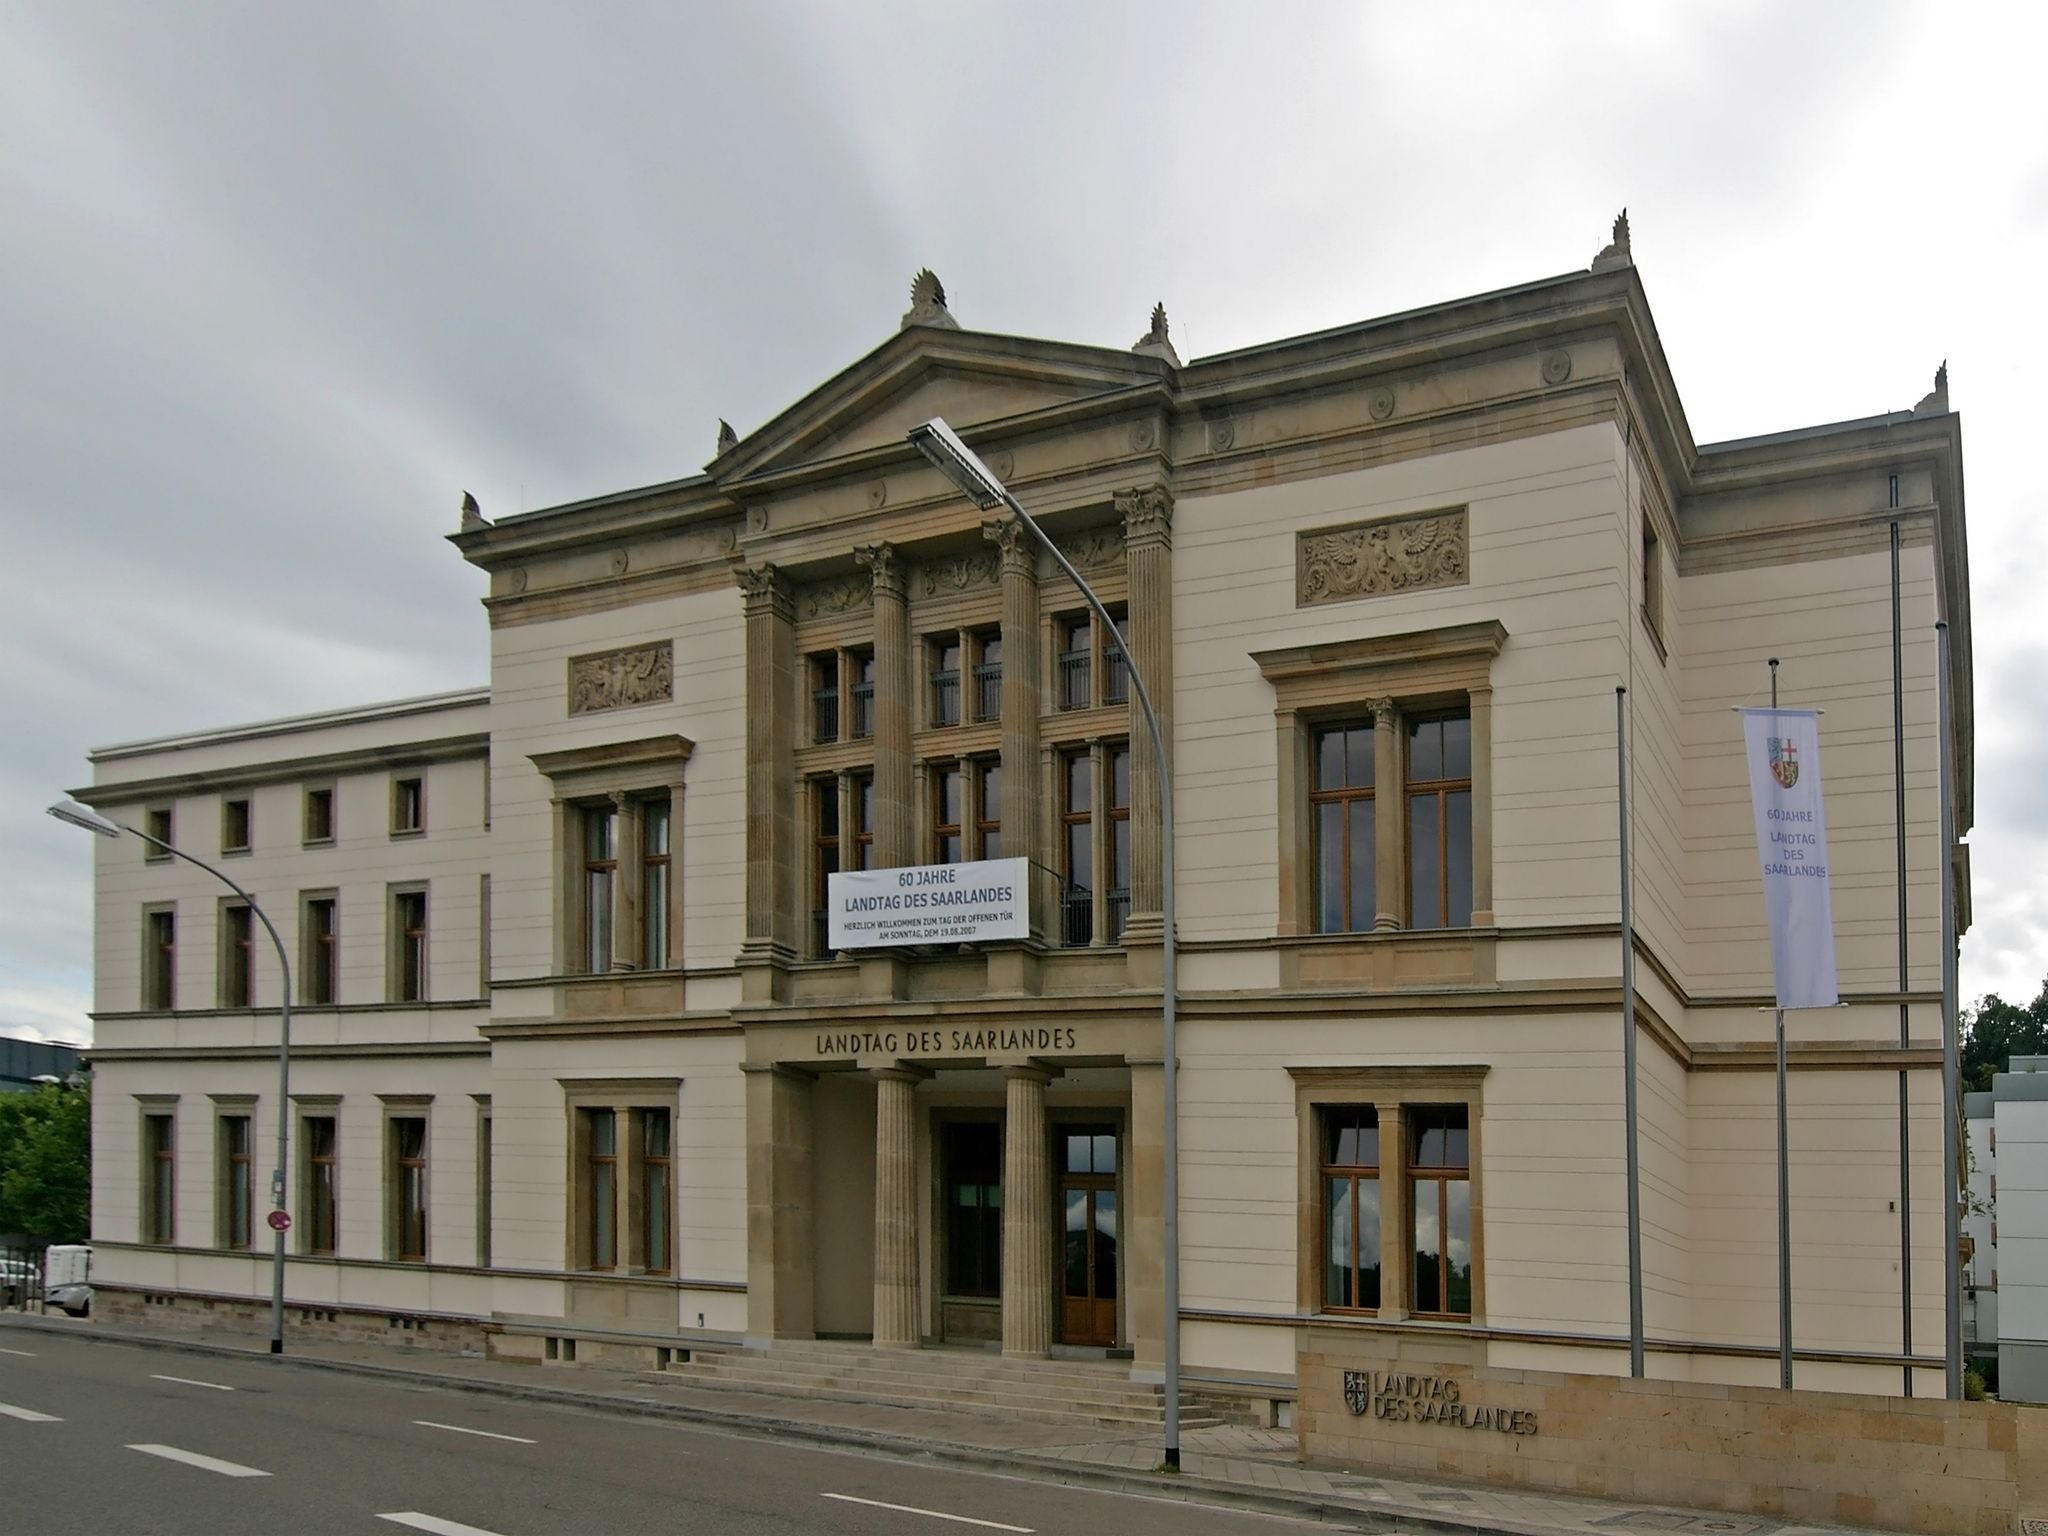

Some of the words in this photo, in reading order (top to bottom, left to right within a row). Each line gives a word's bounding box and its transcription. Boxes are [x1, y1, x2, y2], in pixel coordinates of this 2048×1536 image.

[1767, 808, 1780, 820] 60
[1781, 809, 1813, 822] JAHRE
[1770, 831, 1816, 845] LANDTAG
[1784, 849, 1804, 860] DES
[899, 872, 914, 887] 60
[916, 869, 956, 886] JAHRE
[1764, 863, 1826, 878] SAARLANDES
[845, 895, 901, 912] LANDTAG
[904, 893, 928, 908] DES
[931, 886, 1012, 907] SAARLANDES
[844, 920, 876, 931] HERZLICH
[877, 918, 921, 929] WILLKOMMEN
[923, 917, 939, 926] ZUM
[940, 916, 952, 925] TAG
[953, 915, 967, 924] DER
[968, 912, 998, 923] OFFENEN
[999, 910, 1013, 920] TÜR
[879, 931, 889, 940] AM
[891, 930, 923, 939] SONNTAG,
[924, 929, 939, 937] DEM
[940, 926, 976, 937] 19.08.2007
[817, 1033, 897, 1054] LANDTAG
[907, 1032, 942, 1052] DES
[951, 1028, 1076, 1051] SAARLANDES
[1374, 1371, 1460, 1401] LANDTAG
[1374, 1396, 1410, 1422] DES
[1414, 1401, 1538, 1435] SAARLANDES
